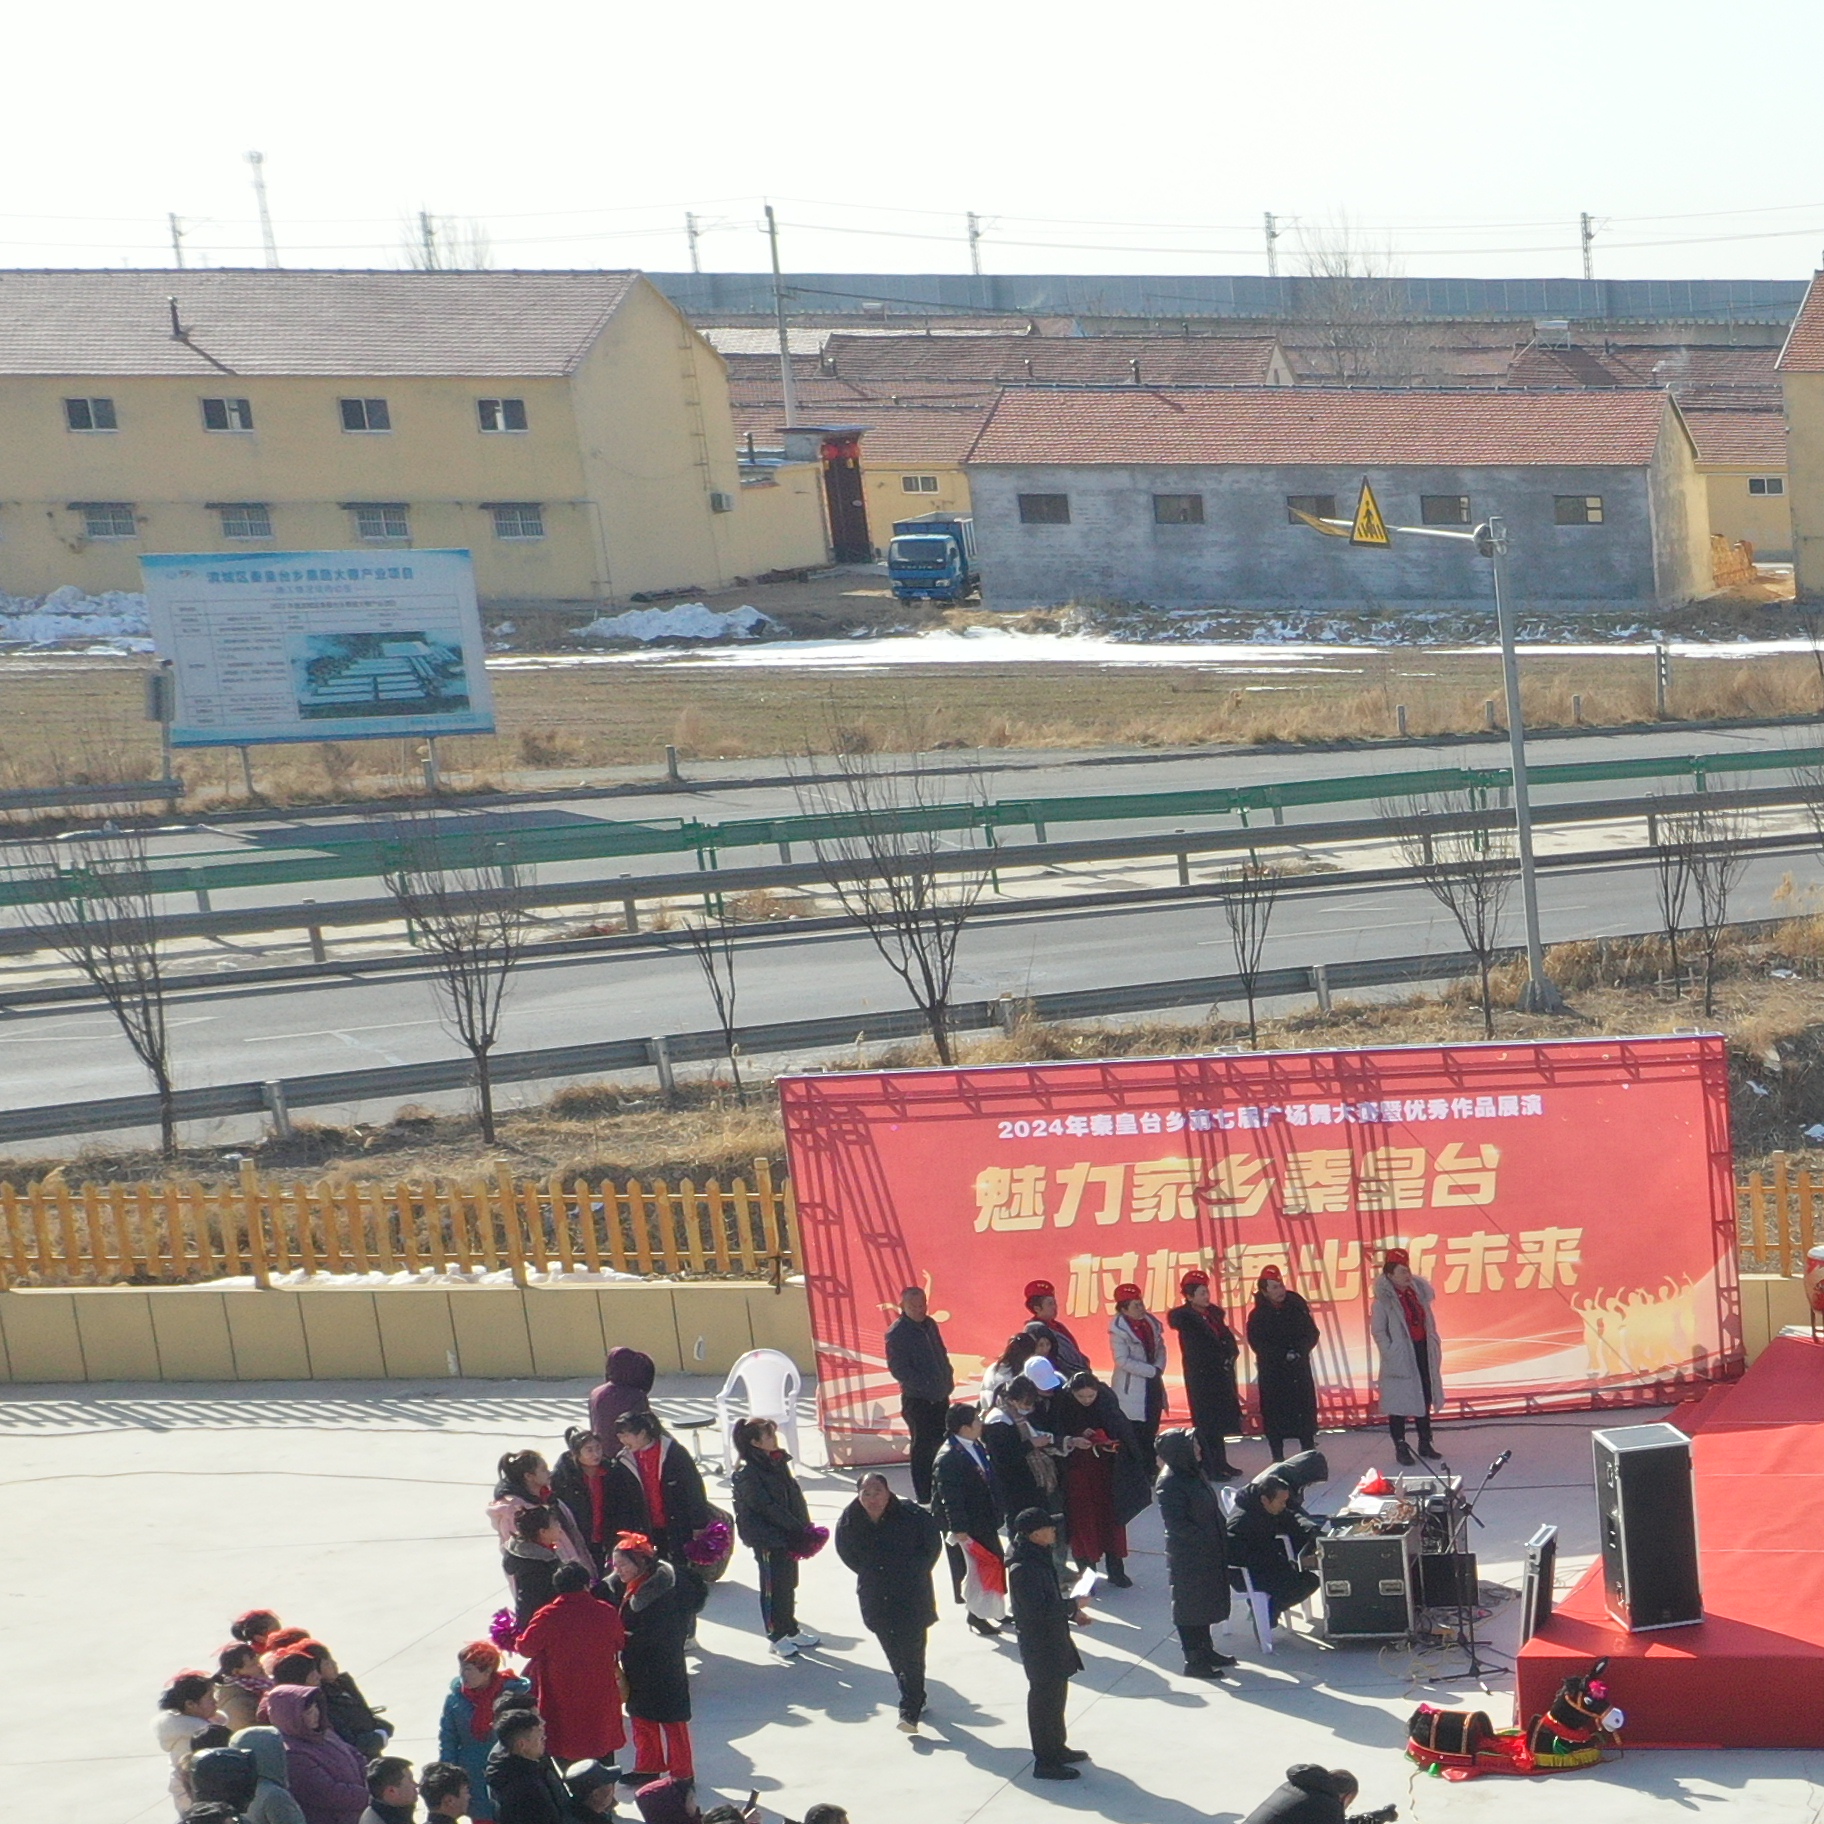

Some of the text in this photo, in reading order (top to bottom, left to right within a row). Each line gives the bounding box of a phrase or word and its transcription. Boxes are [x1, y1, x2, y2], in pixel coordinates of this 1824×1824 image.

[997, 1095, 1543, 1140] 2024年秦皇台乡第七届广场舞大赛暨优秀作品展演
[973, 1142, 1499, 1234] 魅力家乡秦皇台
